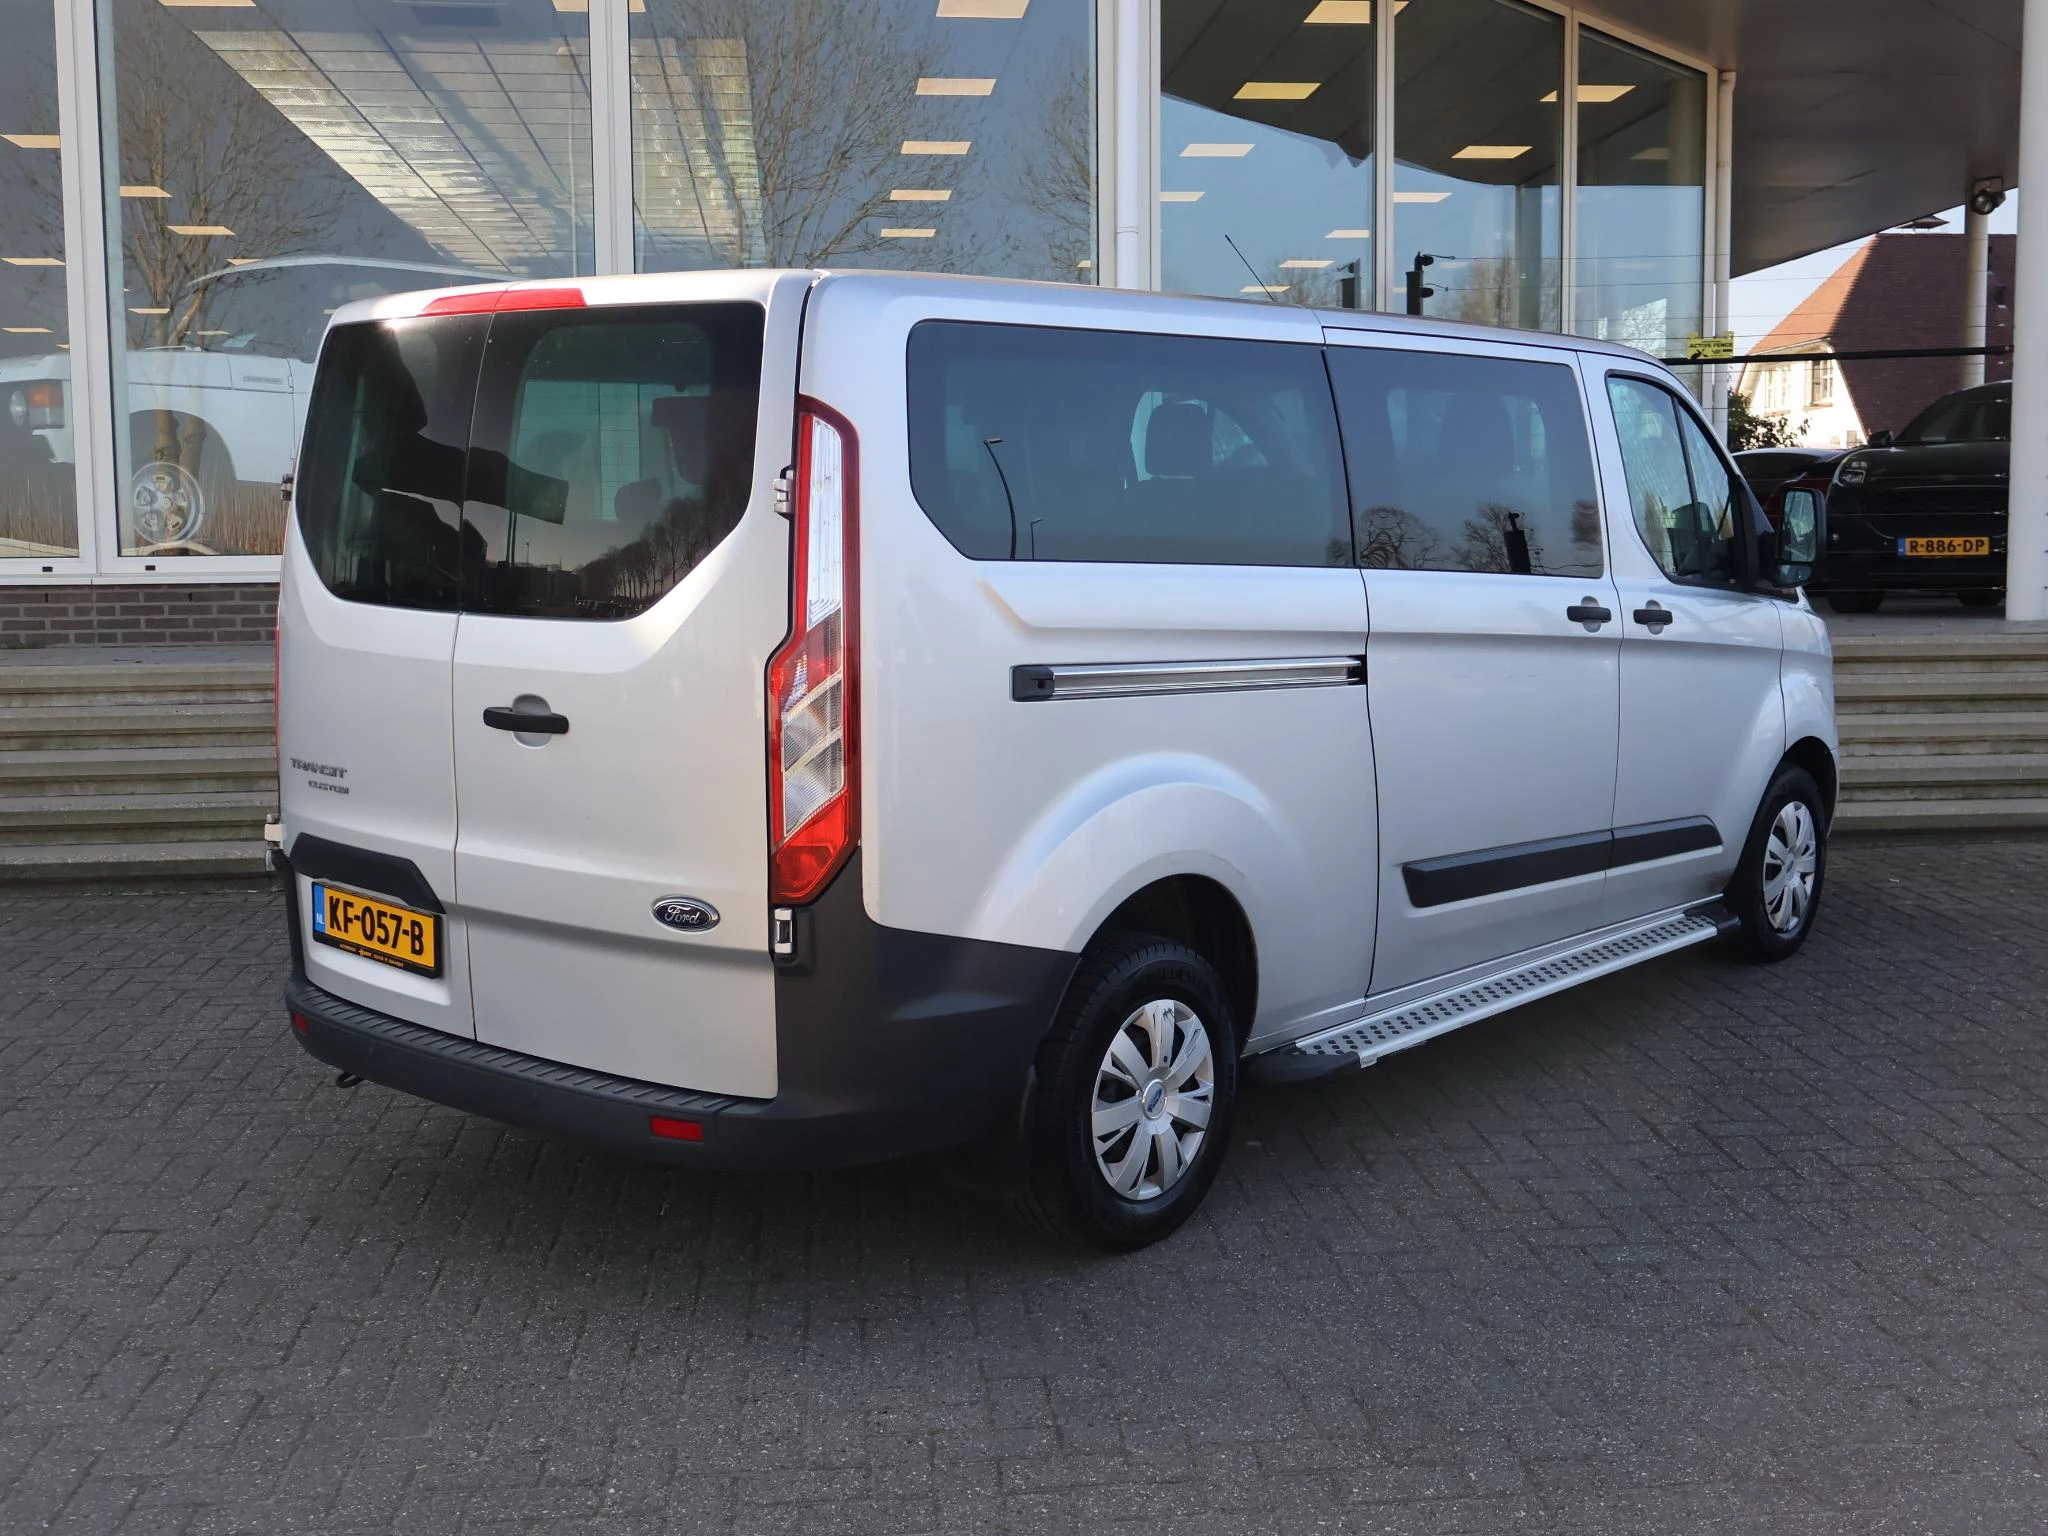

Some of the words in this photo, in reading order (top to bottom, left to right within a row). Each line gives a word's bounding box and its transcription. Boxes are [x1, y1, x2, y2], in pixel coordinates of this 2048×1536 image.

[1909, 539, 1985, 553] R-886-DP
[316, 912, 325, 925] NL
[664, 904, 700, 924] Ford
[329, 895, 424, 956] KF-057-B
